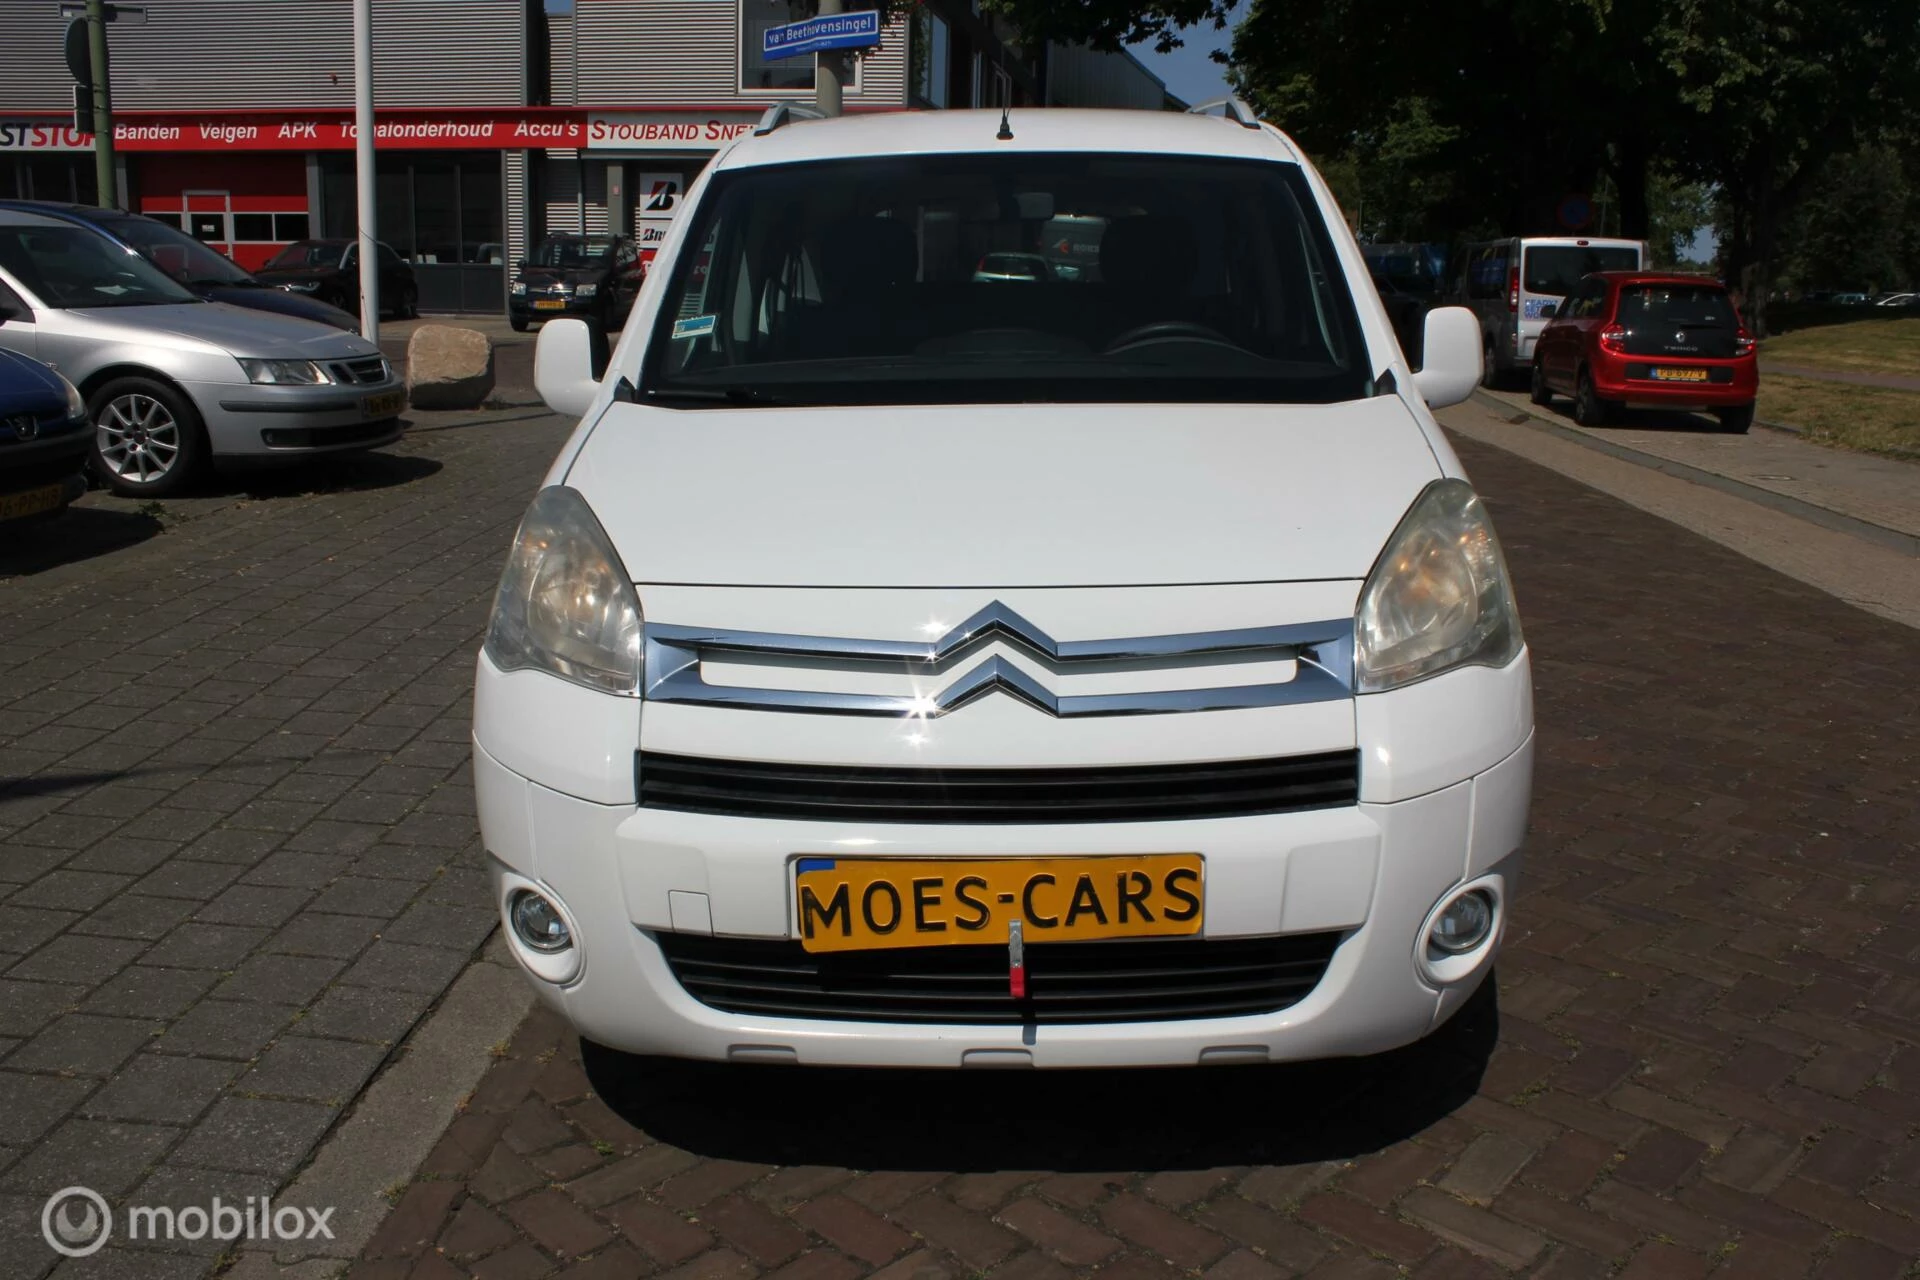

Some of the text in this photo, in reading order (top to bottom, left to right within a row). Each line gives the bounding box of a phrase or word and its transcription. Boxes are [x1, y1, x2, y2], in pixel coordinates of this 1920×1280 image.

[768, 16, 871, 45] van Beethovensingel
[115, 119, 579, 143] Banden Velgen APK Toalonderhoud Accu's
[800, 868, 1201, 939] MOES-CARS
